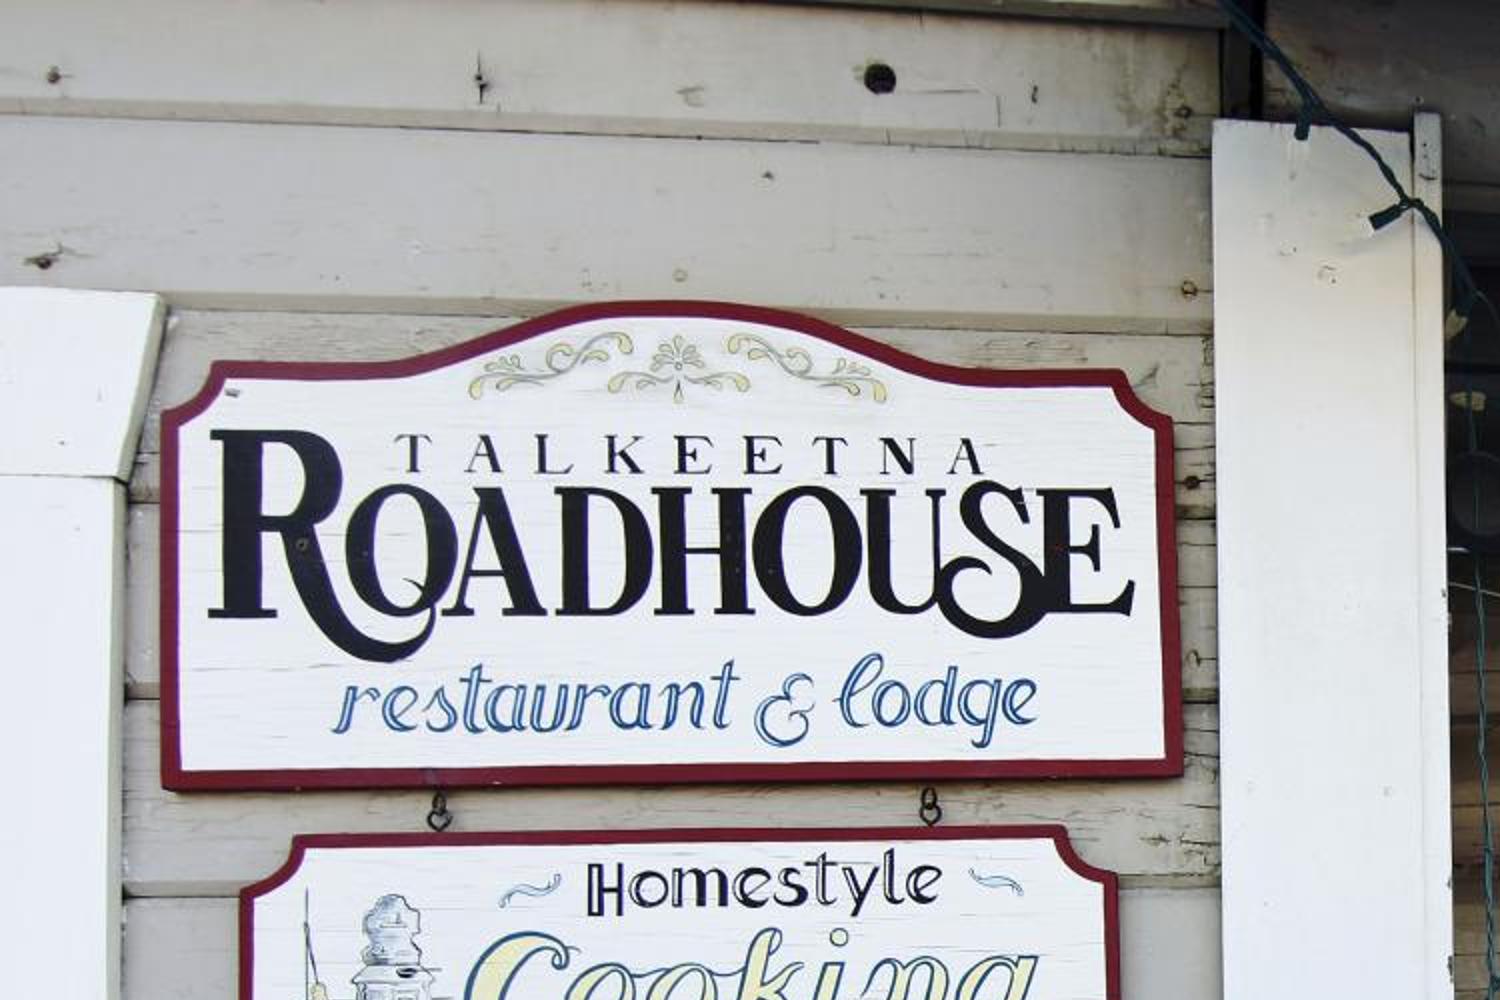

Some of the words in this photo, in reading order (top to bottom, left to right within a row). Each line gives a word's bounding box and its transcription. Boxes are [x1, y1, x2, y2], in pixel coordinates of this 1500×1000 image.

[394, 433, 986, 477] TALKEETNA
[206, 428, 1136, 663] ROADHOUSE
[330, 658, 742, 736] restaurant
[753, 672, 815, 749] &
[834, 652, 1038, 750] lodge
[586, 849, 944, 919] Homestyle
